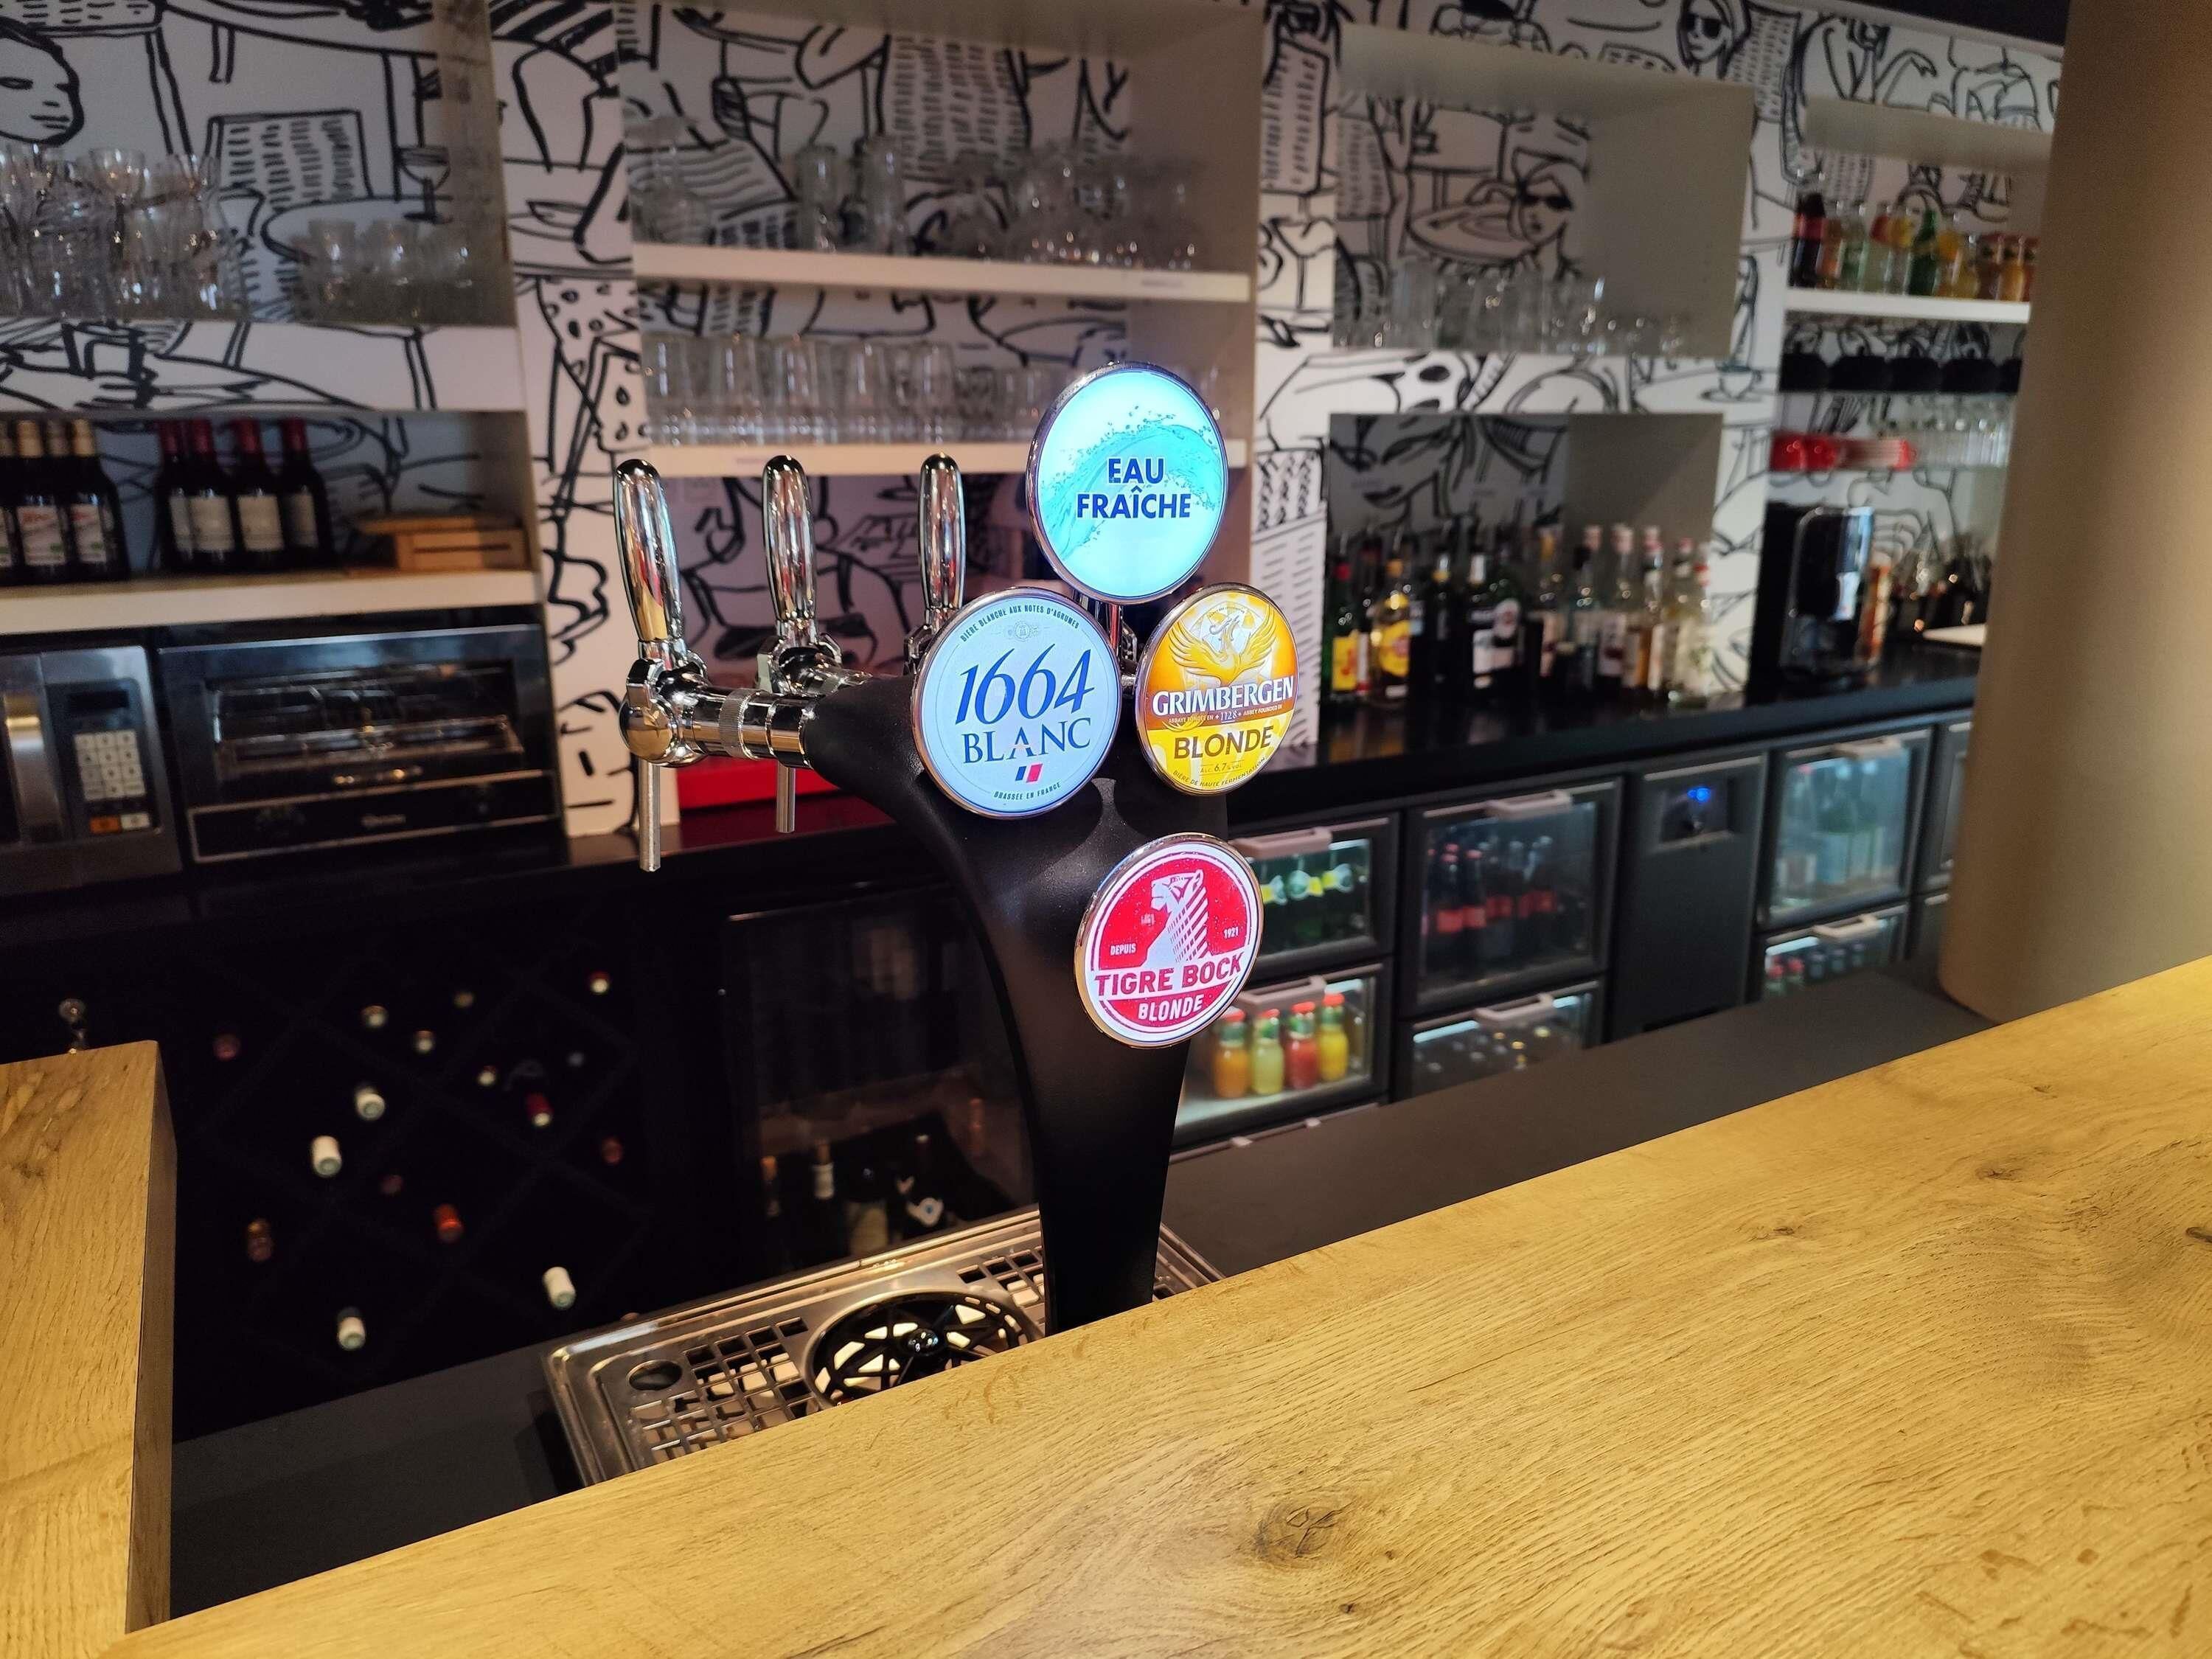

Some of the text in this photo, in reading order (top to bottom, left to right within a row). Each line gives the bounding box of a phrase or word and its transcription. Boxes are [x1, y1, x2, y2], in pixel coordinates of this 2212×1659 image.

[1108, 459, 1164, 484] EAU
[1077, 486, 1191, 518] FRAÎCHE
[978, 610, 1007, 627] BLANCHE
[1009, 605, 1022, 614] AUX
[1024, 605, 1044, 613] NOTES
[1046, 607, 1079, 630] D'AGRUMES
[955, 644, 1094, 726] 1664
[1152, 676, 1293, 716] GRIMBERGEN
[1221, 711, 1237, 720] 1128
[962, 717, 1091, 764] BLANC
[1174, 726, 1273, 759] BLONDE
[1037, 782, 1061, 797] FRANCE
[1110, 926, 1239, 956] DEPUIS 1921
[1094, 952, 1245, 996] TIGRE BOCK
[1138, 994, 1205, 1021] BLONDE
